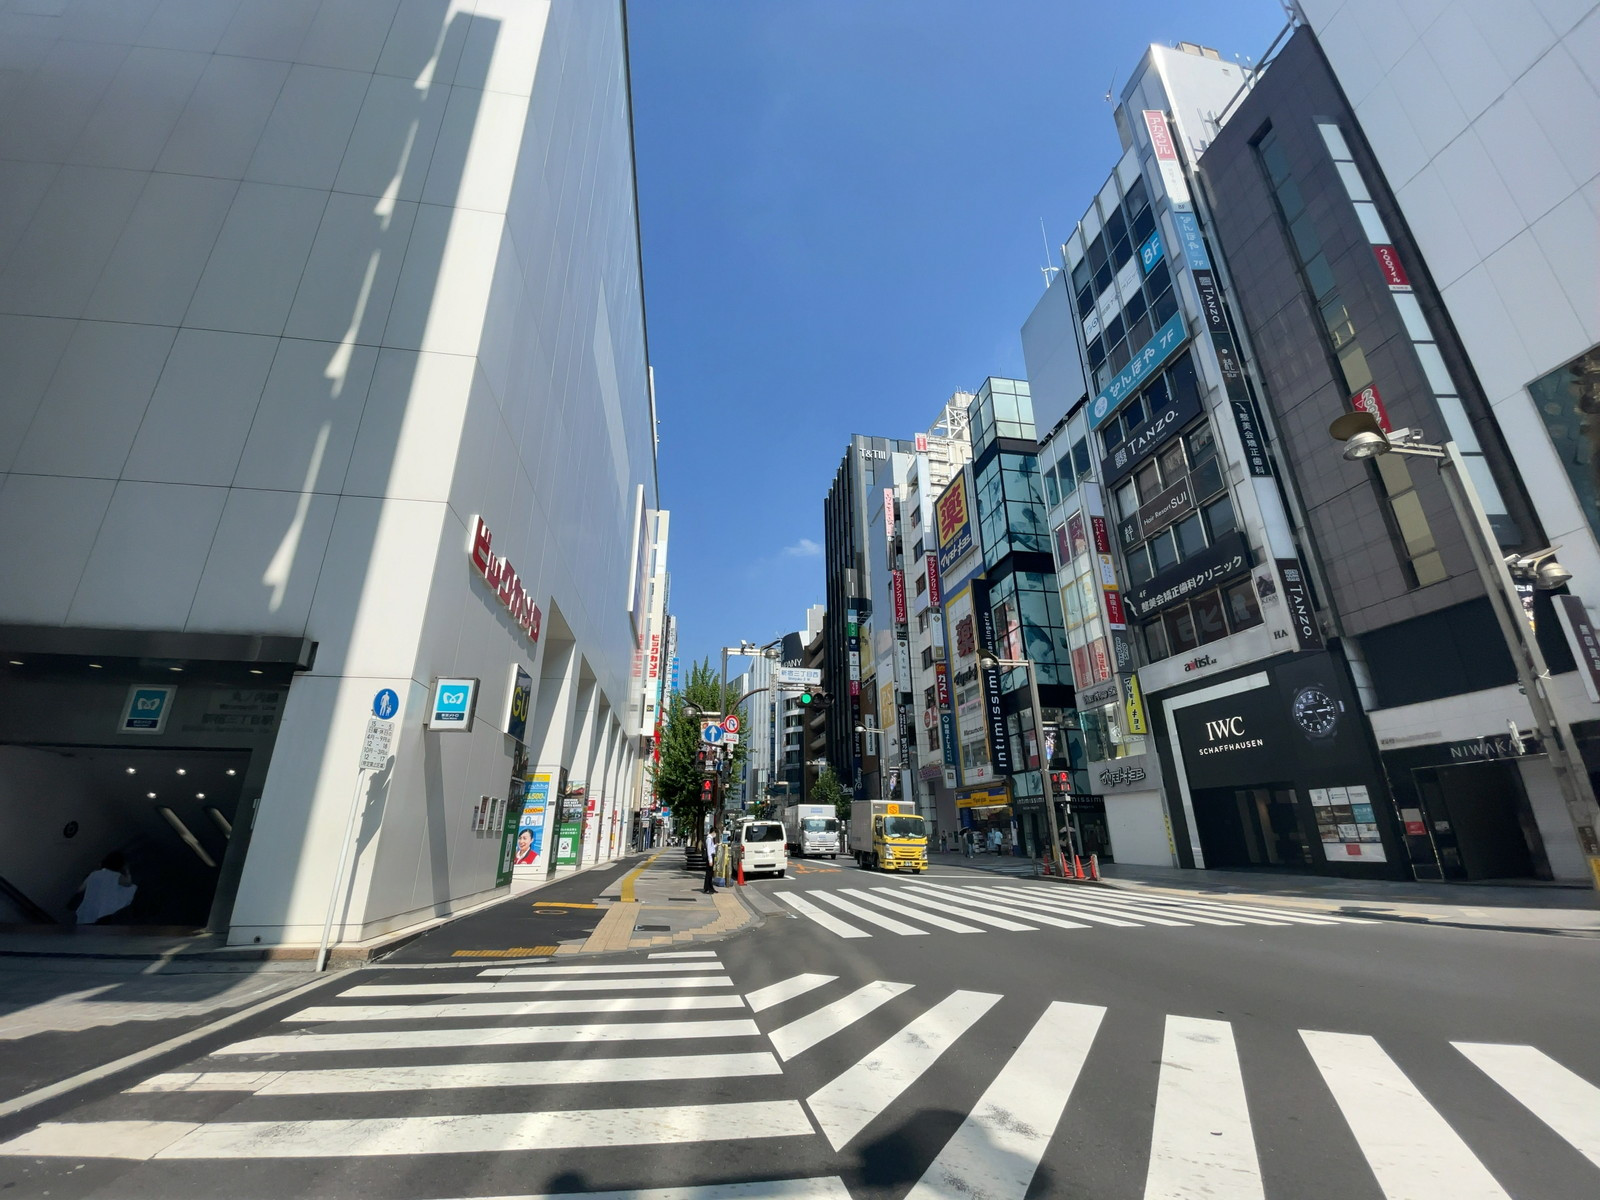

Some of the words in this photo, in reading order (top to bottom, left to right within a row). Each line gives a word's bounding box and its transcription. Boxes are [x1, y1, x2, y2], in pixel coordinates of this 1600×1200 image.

[1179, 215, 1199, 250] なんぼや
[1143, 237, 1160, 265] 8F
[1109, 347, 1156, 397] なんぼや
[1160, 328, 1174, 349] 7F
[940, 482, 964, 541] 薬
[1154, 504, 1171, 519] Resort
[1170, 491, 1188, 509] SUI
[955, 613, 975, 658] 薬
[938, 674, 947, 700] ガスト
[512, 688, 528, 722] GU
[1205, 716, 1245, 741] IWC
[1198, 738, 1264, 756] SCHAFFHAUSEN
